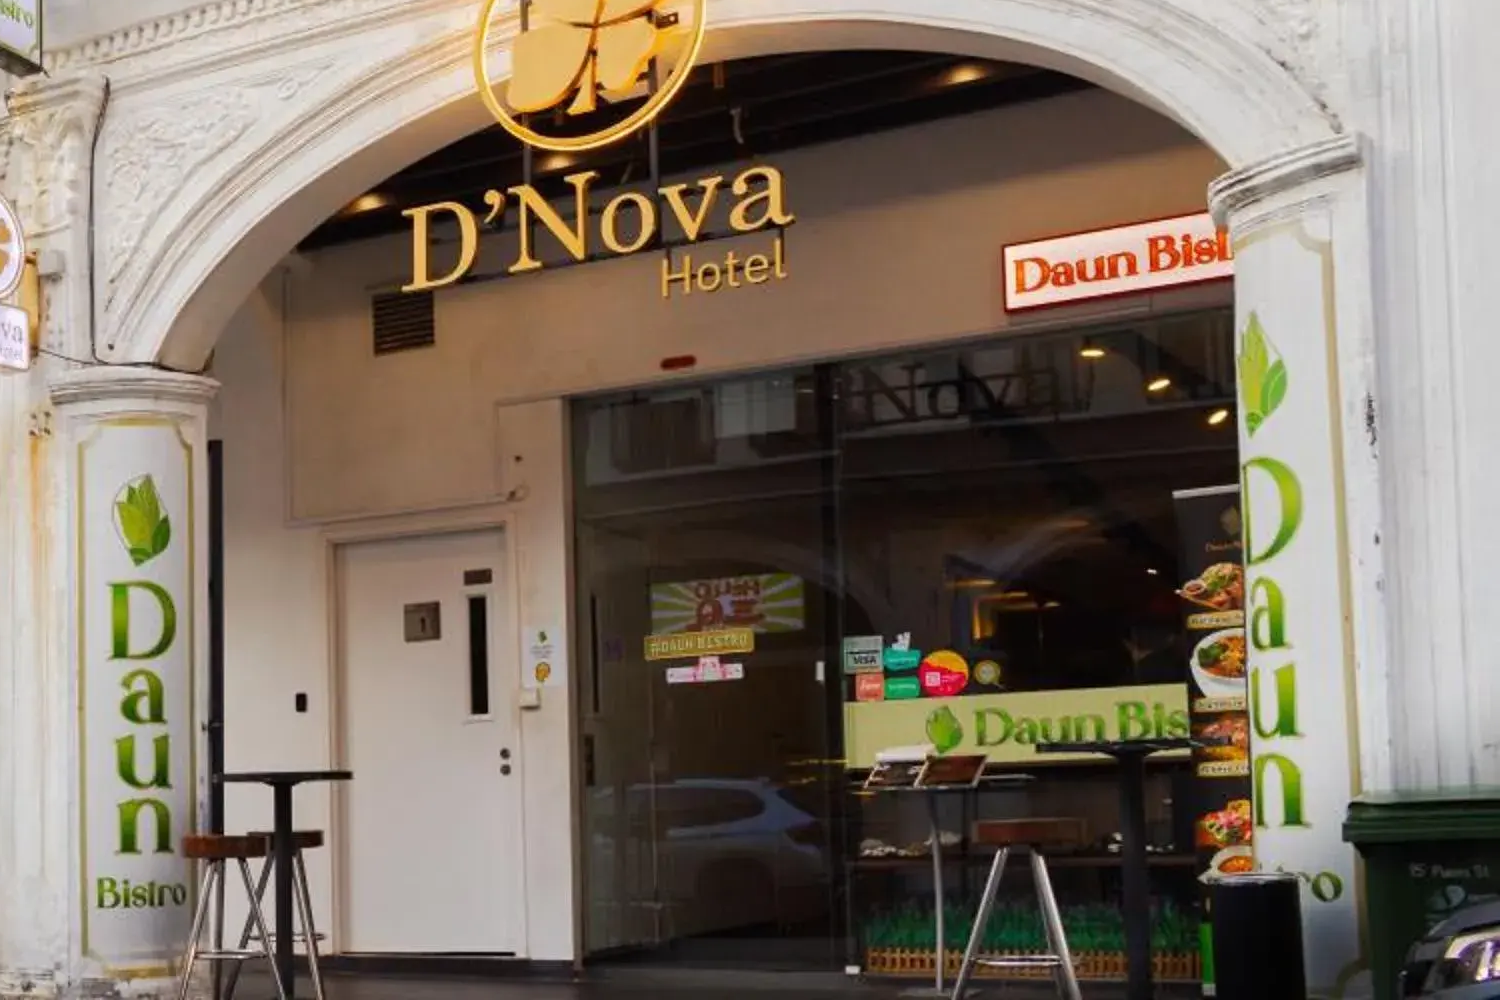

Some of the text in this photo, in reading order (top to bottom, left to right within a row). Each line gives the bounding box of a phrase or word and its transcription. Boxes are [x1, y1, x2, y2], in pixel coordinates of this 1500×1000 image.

[401, 165, 797, 293] D'Nova
[662, 238, 789, 299] Hotel
[1013, 230, 1235, 294] Daun Bist
[853, 654, 877, 665] VISA
[1241, 456, 1313, 830] Daun
[106, 581, 177, 855] Daun
[974, 700, 1188, 746] Daun Bis
[96, 877, 187, 909] Bistro
